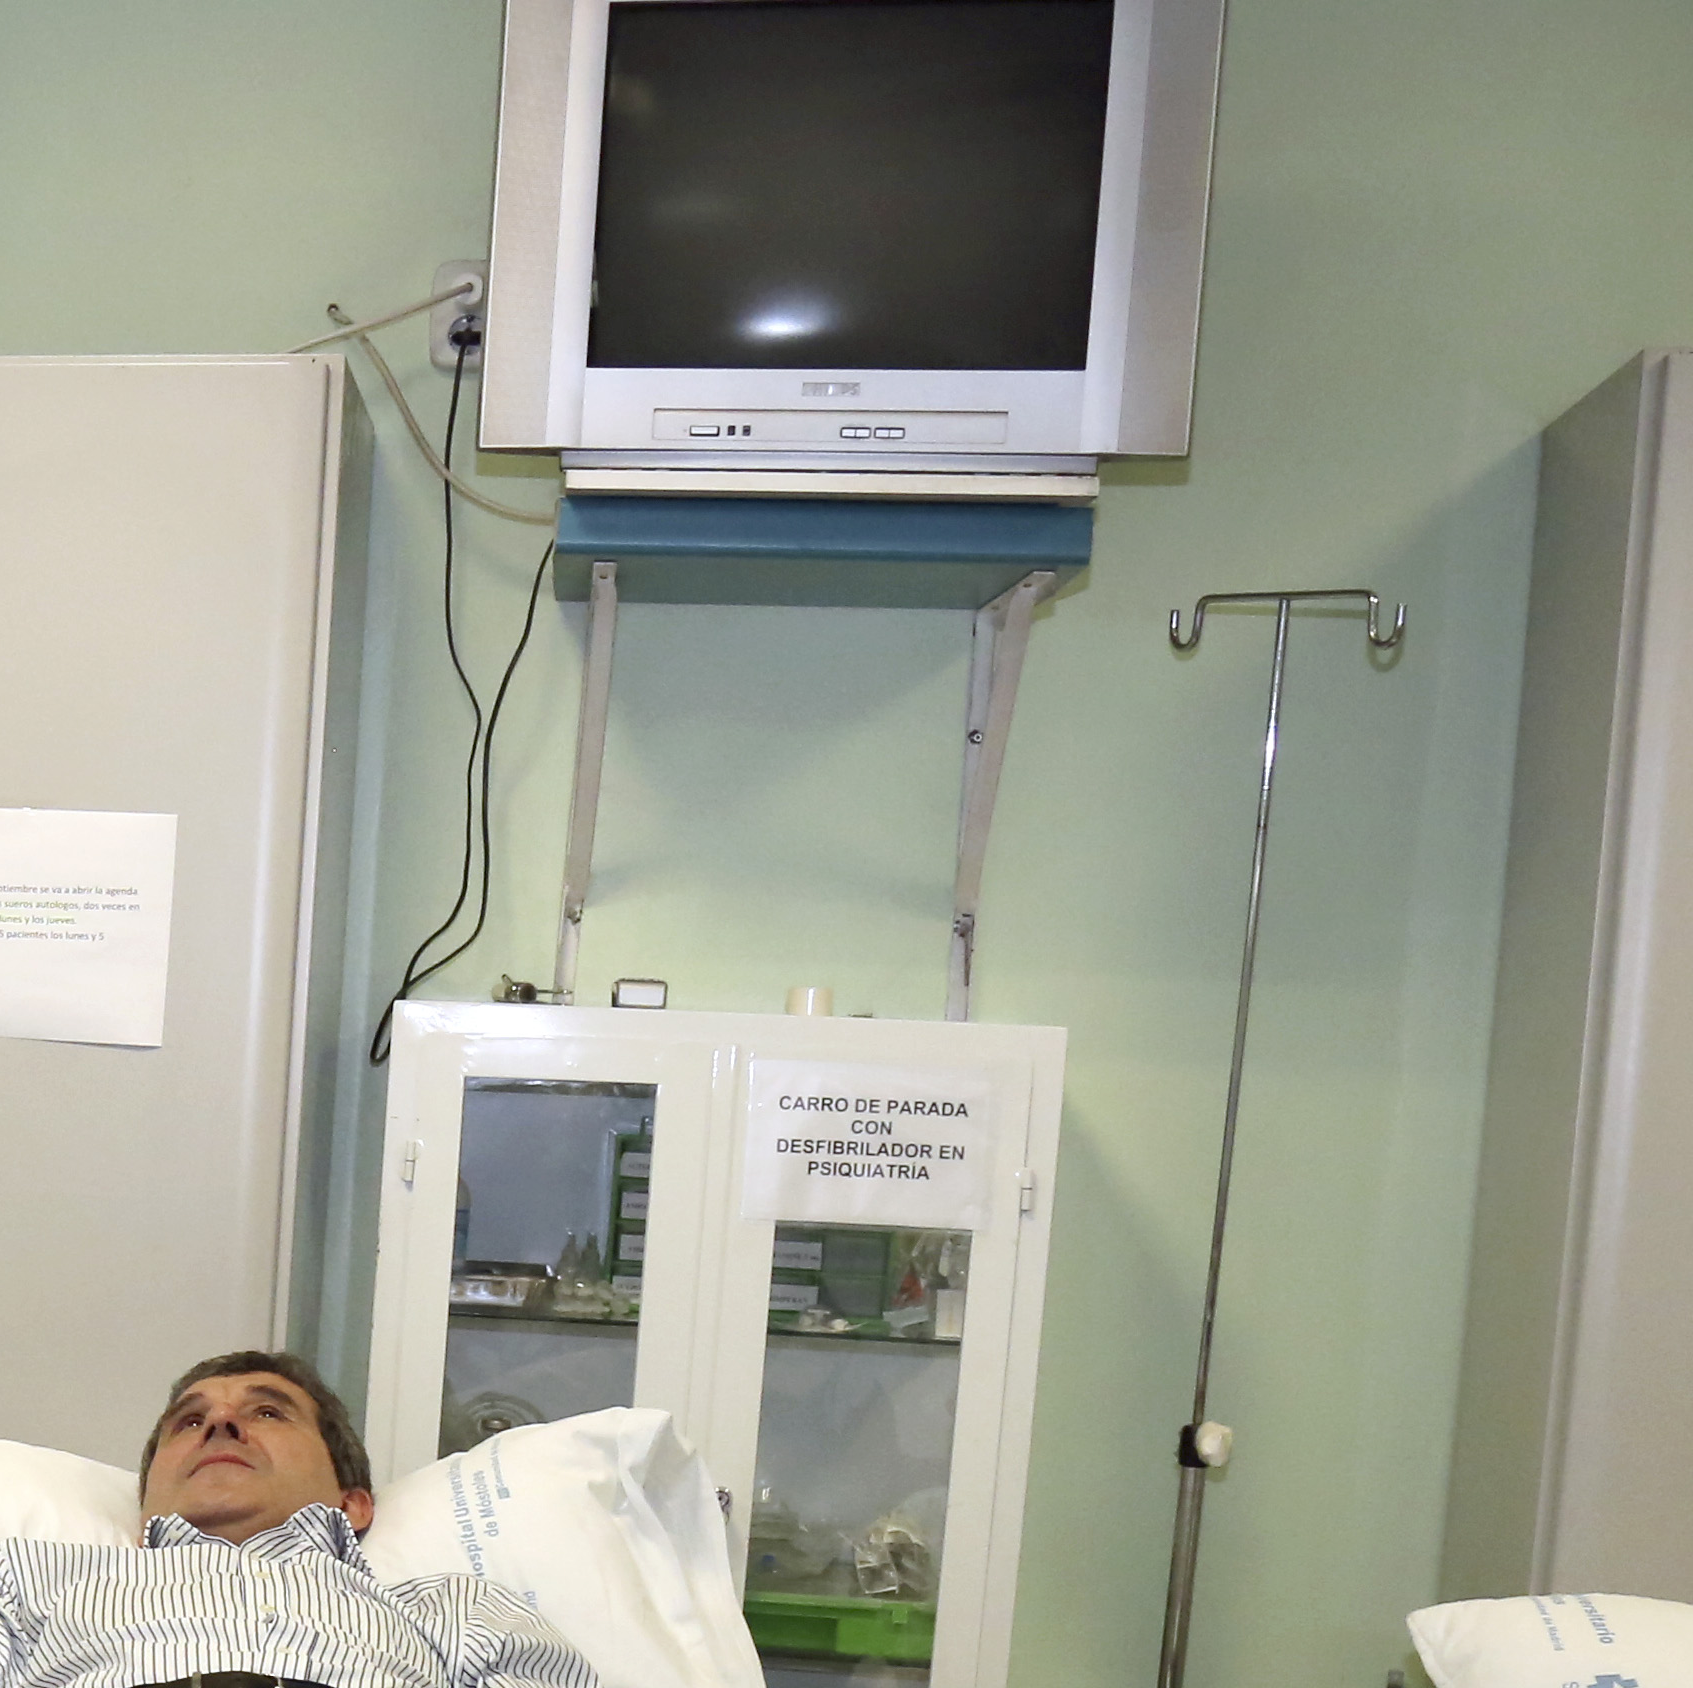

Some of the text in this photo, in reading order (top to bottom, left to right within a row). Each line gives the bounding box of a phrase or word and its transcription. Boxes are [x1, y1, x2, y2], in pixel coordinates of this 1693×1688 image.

[40, 886, 50, 894] se
[52, 886, 61, 894] va
[72, 886, 93, 895] abrir
[95, 886, 103, 895] la
[105, 887, 138, 897] agenda
[4, 901, 33, 909] sueros
[83, 901, 99, 910] dos
[102, 903, 126, 911] veces
[0, 914, 22, 924] lunes
[24, 917, 29, 925] y
[32, 915, 44, 924] los
[6, 931, 48, 941] pacientes
[51, 931, 63, 940] los
[66, 932, 89, 940] lunes
[91, 934, 96, 942] y
[779, 1095, 968, 1117] CARRO DE PARADA
[851, 1120, 893, 1135] CON
[777, 1138, 965, 1160] DESFIBRILADOR EN
[808, 1161, 930, 1180] PSIQUIATRÍA
[472, 1470, 499, 1537] de Móstoles
